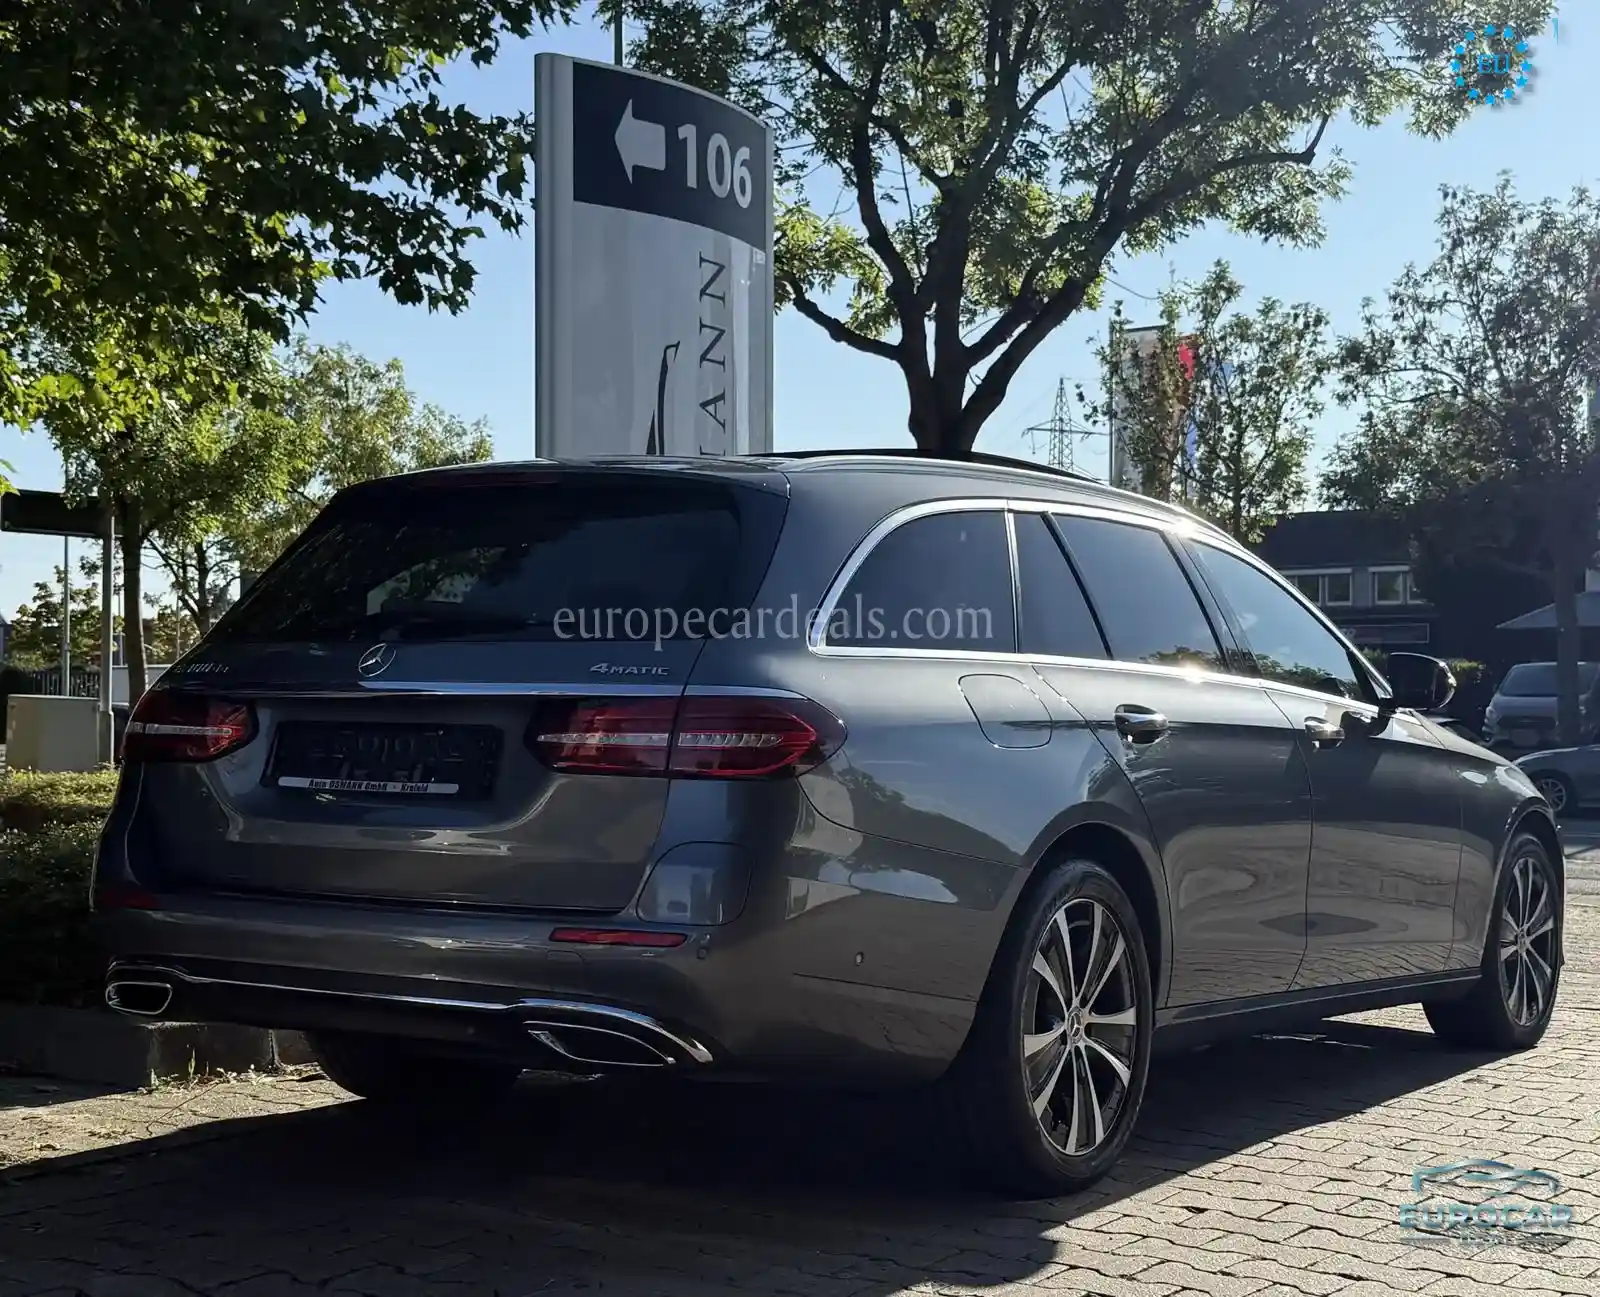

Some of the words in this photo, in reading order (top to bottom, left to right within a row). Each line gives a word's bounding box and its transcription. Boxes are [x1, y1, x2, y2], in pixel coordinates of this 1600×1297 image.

[677, 123, 752, 209] 106
[699, 250, 726, 456] ANN
[589, 662, 670, 676] 4MATIC
